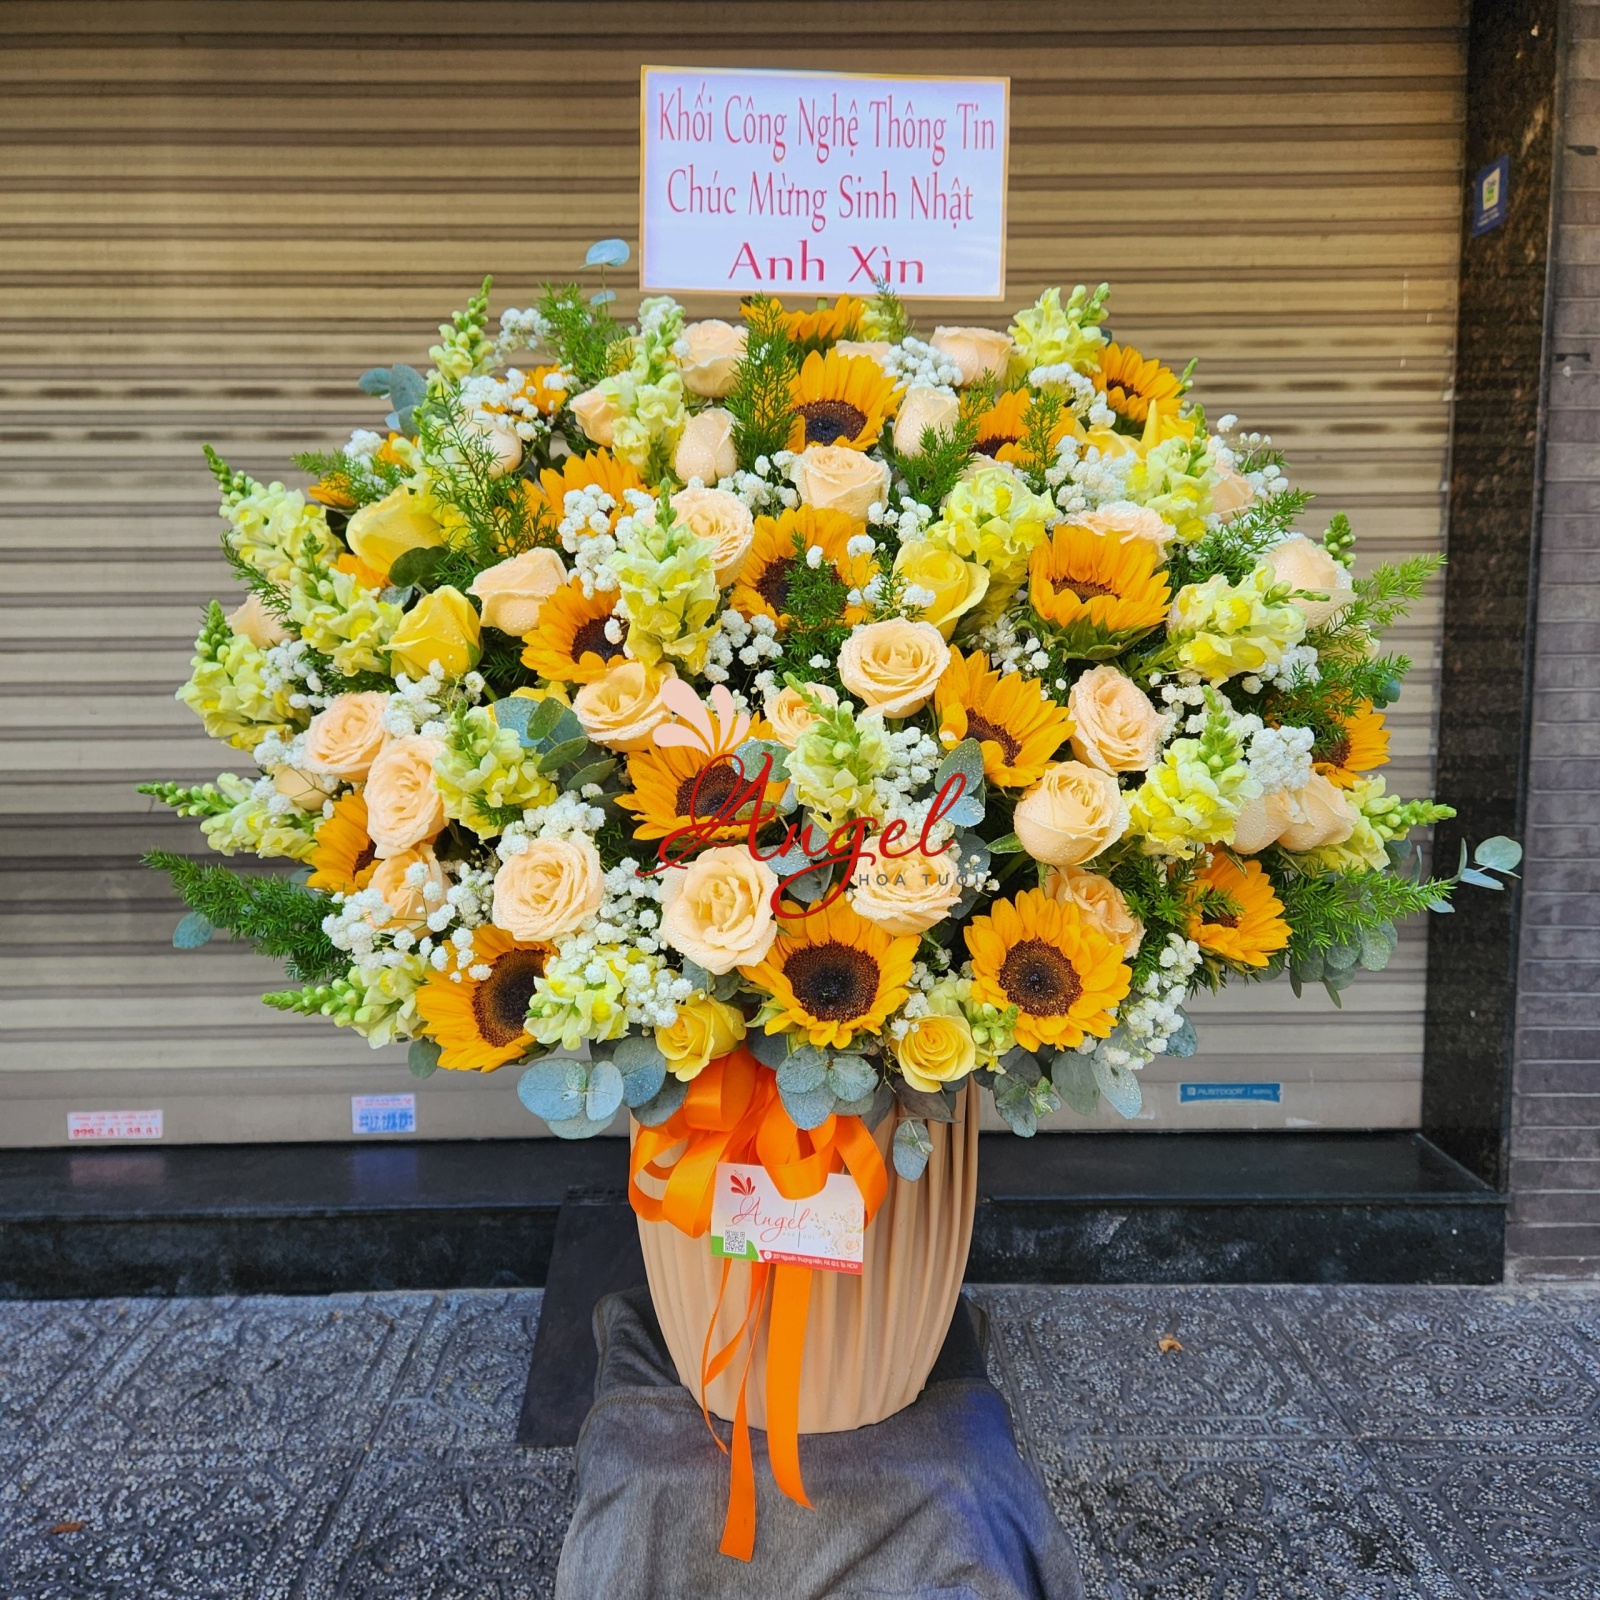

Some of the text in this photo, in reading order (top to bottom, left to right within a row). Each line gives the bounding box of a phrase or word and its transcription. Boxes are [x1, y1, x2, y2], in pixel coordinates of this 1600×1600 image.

[659, 82, 995, 167] Khối Công Nghệ Thông Tin
[667, 164, 975, 233] Chúc Mừng Sinh Nhật
[728, 239, 925, 284] Anh Xìn
[726, 1196, 811, 1243] Angel
